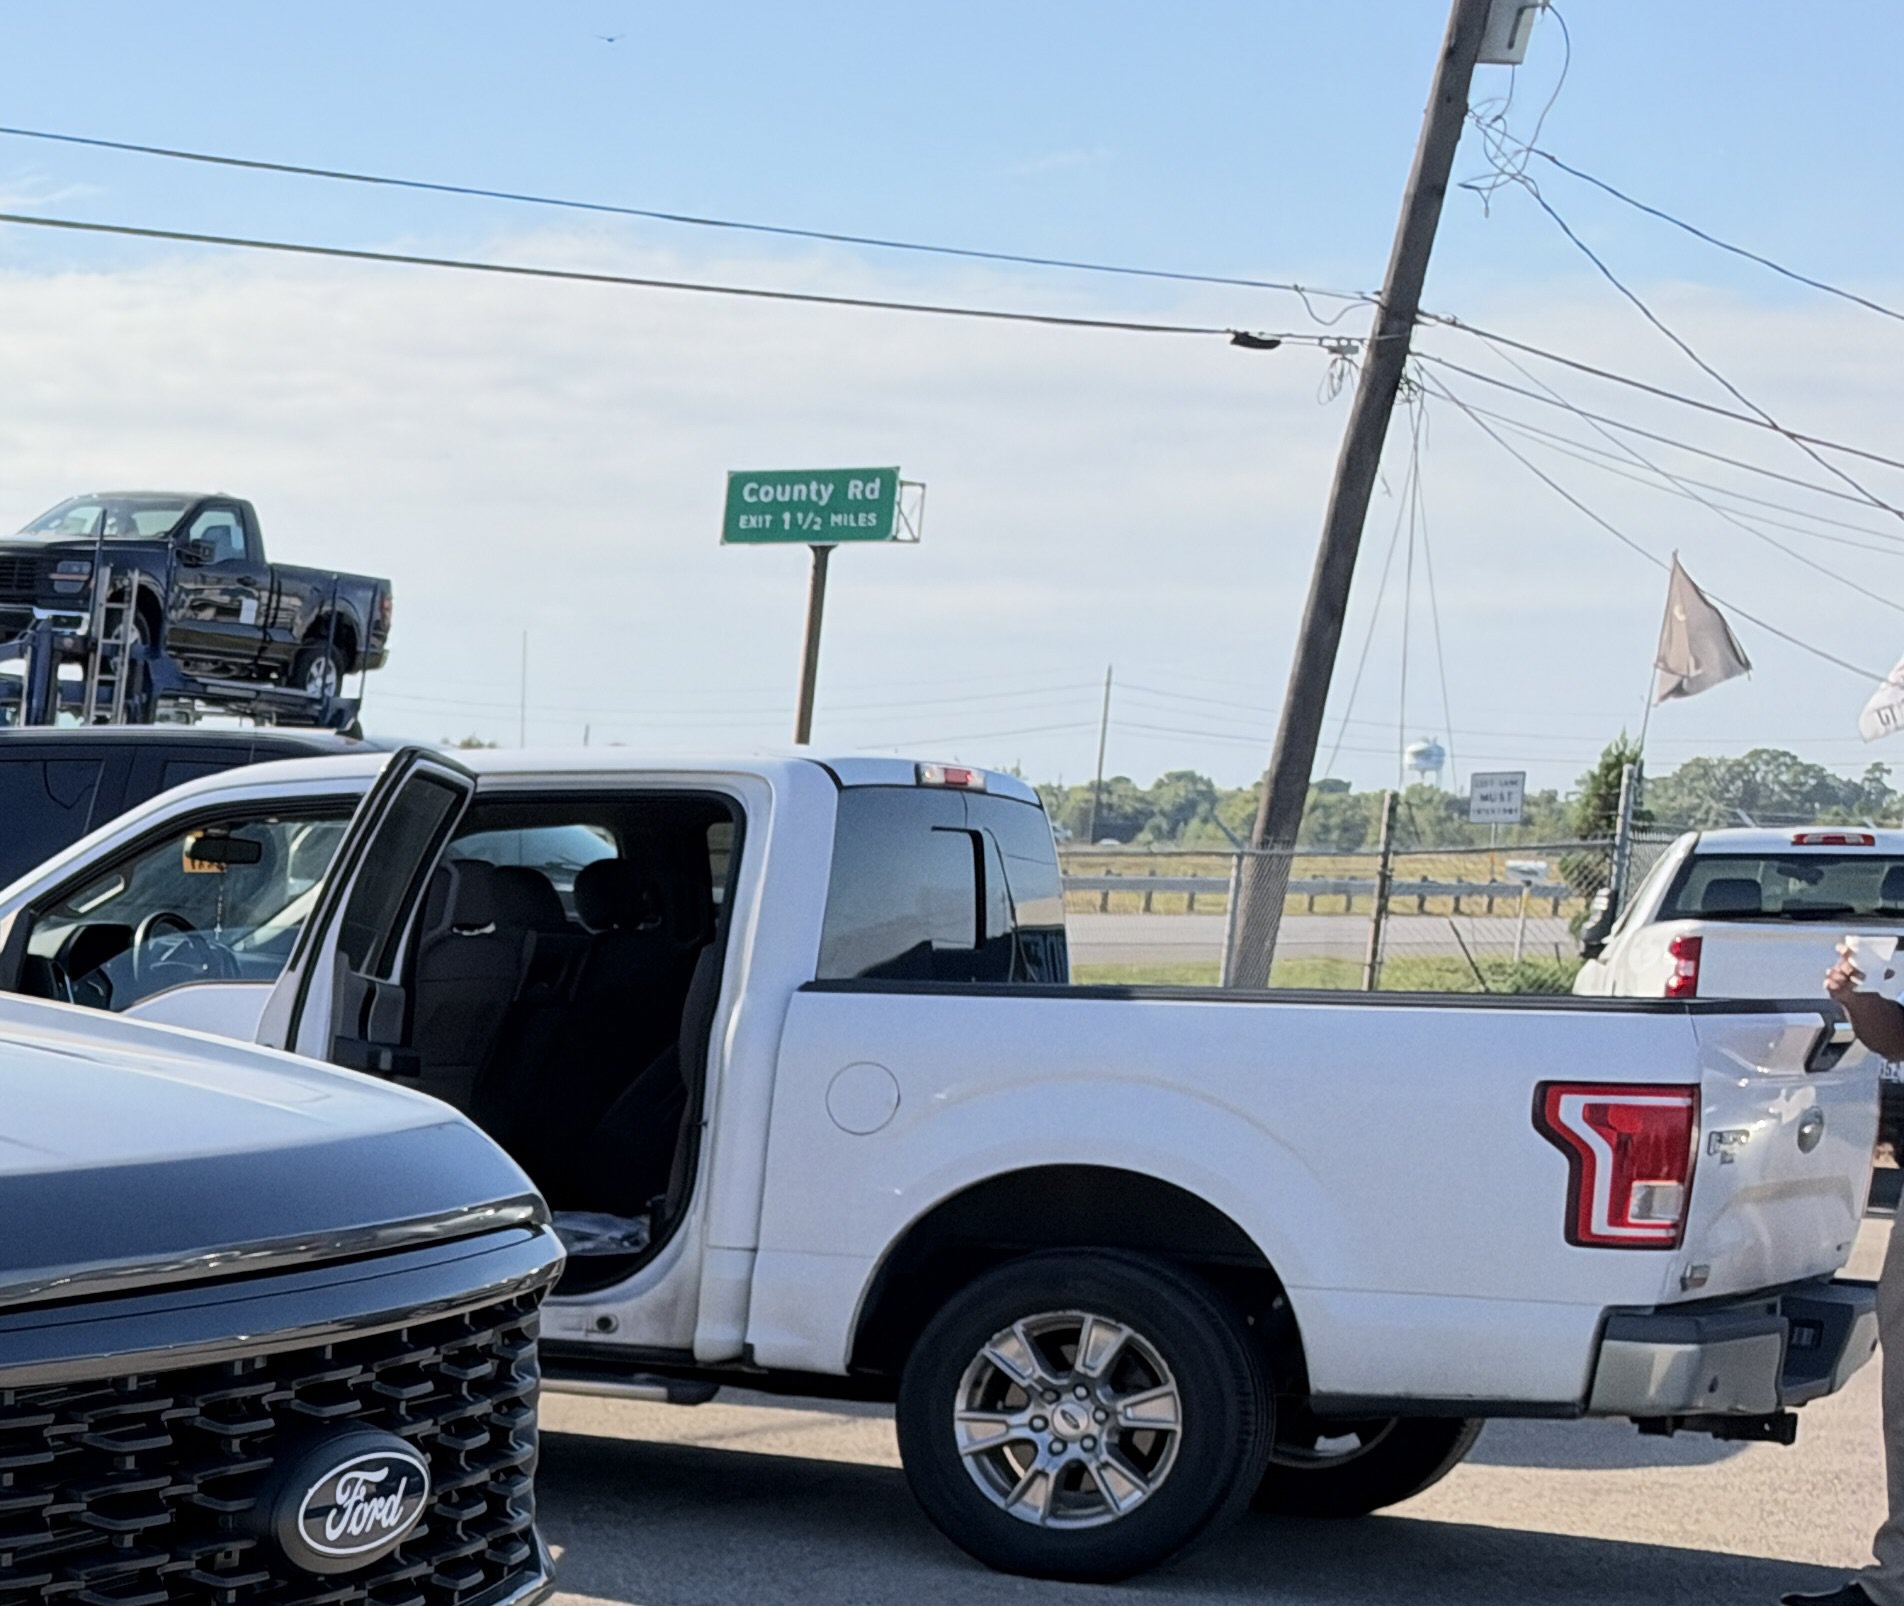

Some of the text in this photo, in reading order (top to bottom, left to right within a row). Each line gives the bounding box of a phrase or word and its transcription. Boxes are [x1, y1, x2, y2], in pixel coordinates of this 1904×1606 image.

[742, 477, 881, 506] County Rd
[739, 514, 772, 529] EXIT
[830, 512, 877, 527] MILES
[325, 1466, 408, 1541] Ford
